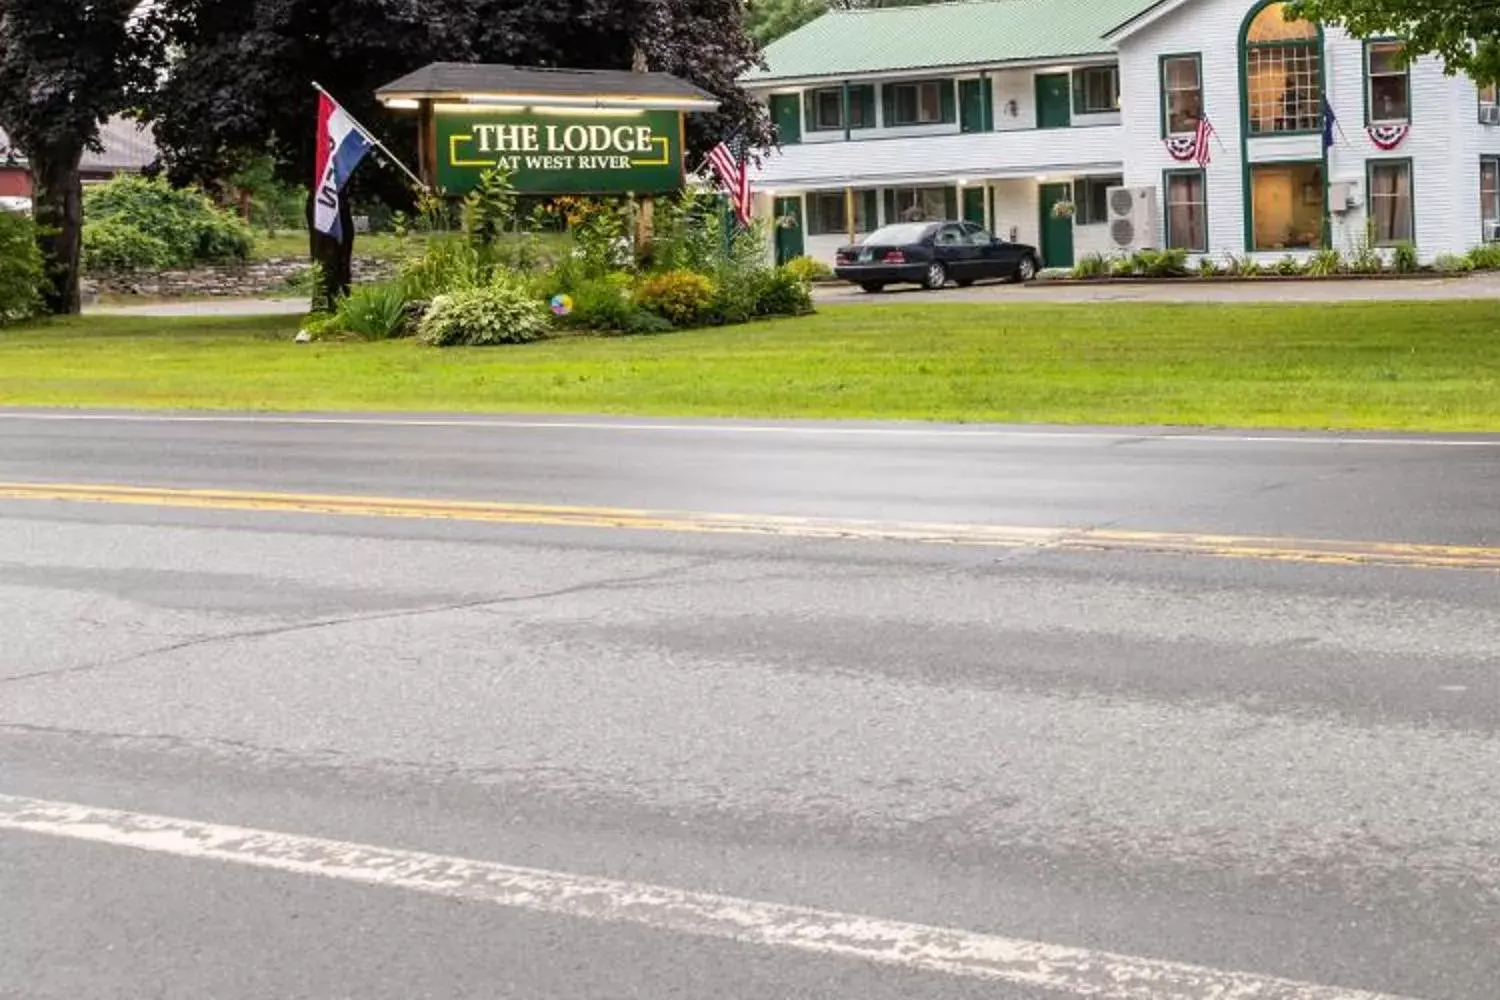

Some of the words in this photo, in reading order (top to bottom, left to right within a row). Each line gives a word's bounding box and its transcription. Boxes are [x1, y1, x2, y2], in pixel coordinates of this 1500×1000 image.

[472, 125, 539, 152] THE
[545, 125, 653, 153] LODGE
[497, 156, 521, 169] AT
[525, 156, 575, 169] WEST
[578, 156, 631, 169] RIVER
